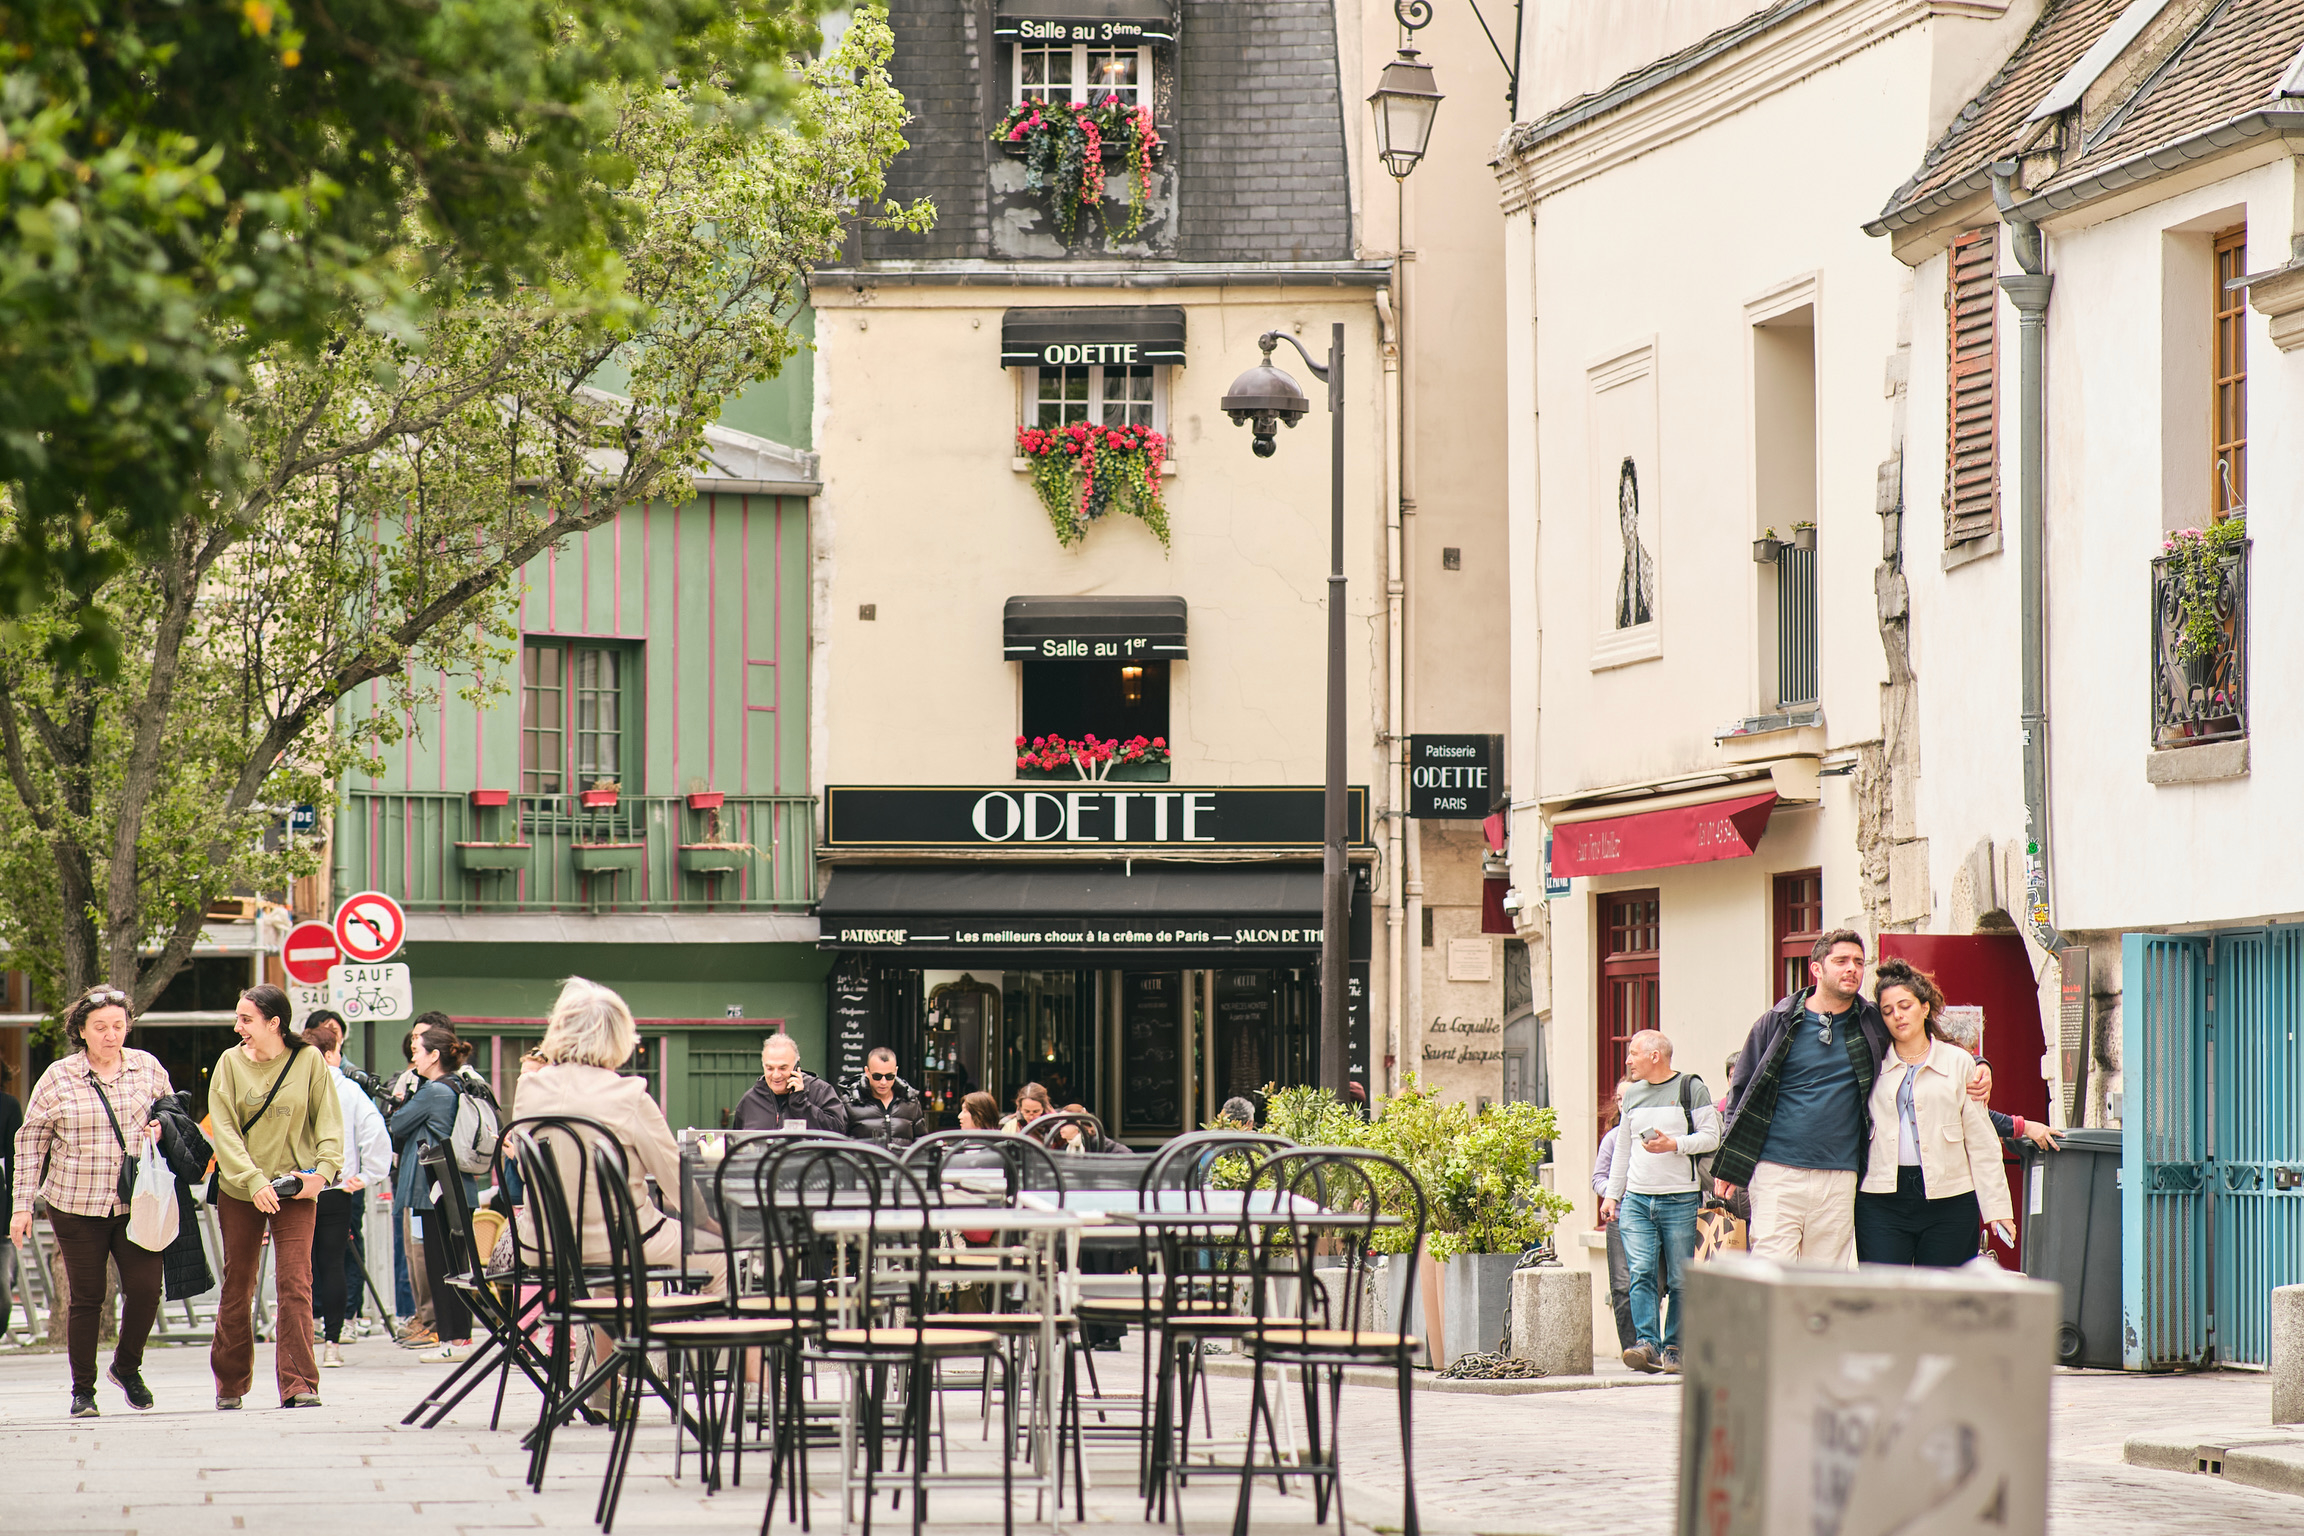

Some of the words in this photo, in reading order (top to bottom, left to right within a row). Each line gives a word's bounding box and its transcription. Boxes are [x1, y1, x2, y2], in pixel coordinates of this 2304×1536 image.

[1020, 20, 1067, 39] Salle
[1072, 26, 1096, 40] au
[1043, 342, 1138, 365] ODETTE
[1042, 639, 1089, 657] Salle
[1094, 643, 1118, 657] au
[1123, 637, 1148, 657] 1er
[1425, 744, 1477, 758] Patisserie
[1412, 765, 1488, 789] ODETTE
[1433, 797, 1468, 811] PARIS
[291, 811, 313, 823] DE
[972, 791, 1216, 842] ODETTE
[841, 929, 908, 945] PATISSERIE
[956, 930, 979, 943] Les
[982, 930, 1042, 943] meilleurs
[1044, 930, 1083, 943] choux
[1086, 930, 1095, 943] à
[1097, 930, 1110, 943] la
[1157, 930, 1172, 943] de
[1175, 930, 1210, 943] Paris
[1234, 929, 1279, 944] SALON
[1281, 929, 1301, 943] DE
[344, 968, 394, 983] SAUF
[302, 991, 330, 1004] SAU
[728, 1007, 742, 1018] 75
[1458, 1045, 1507, 1065] Jacques
